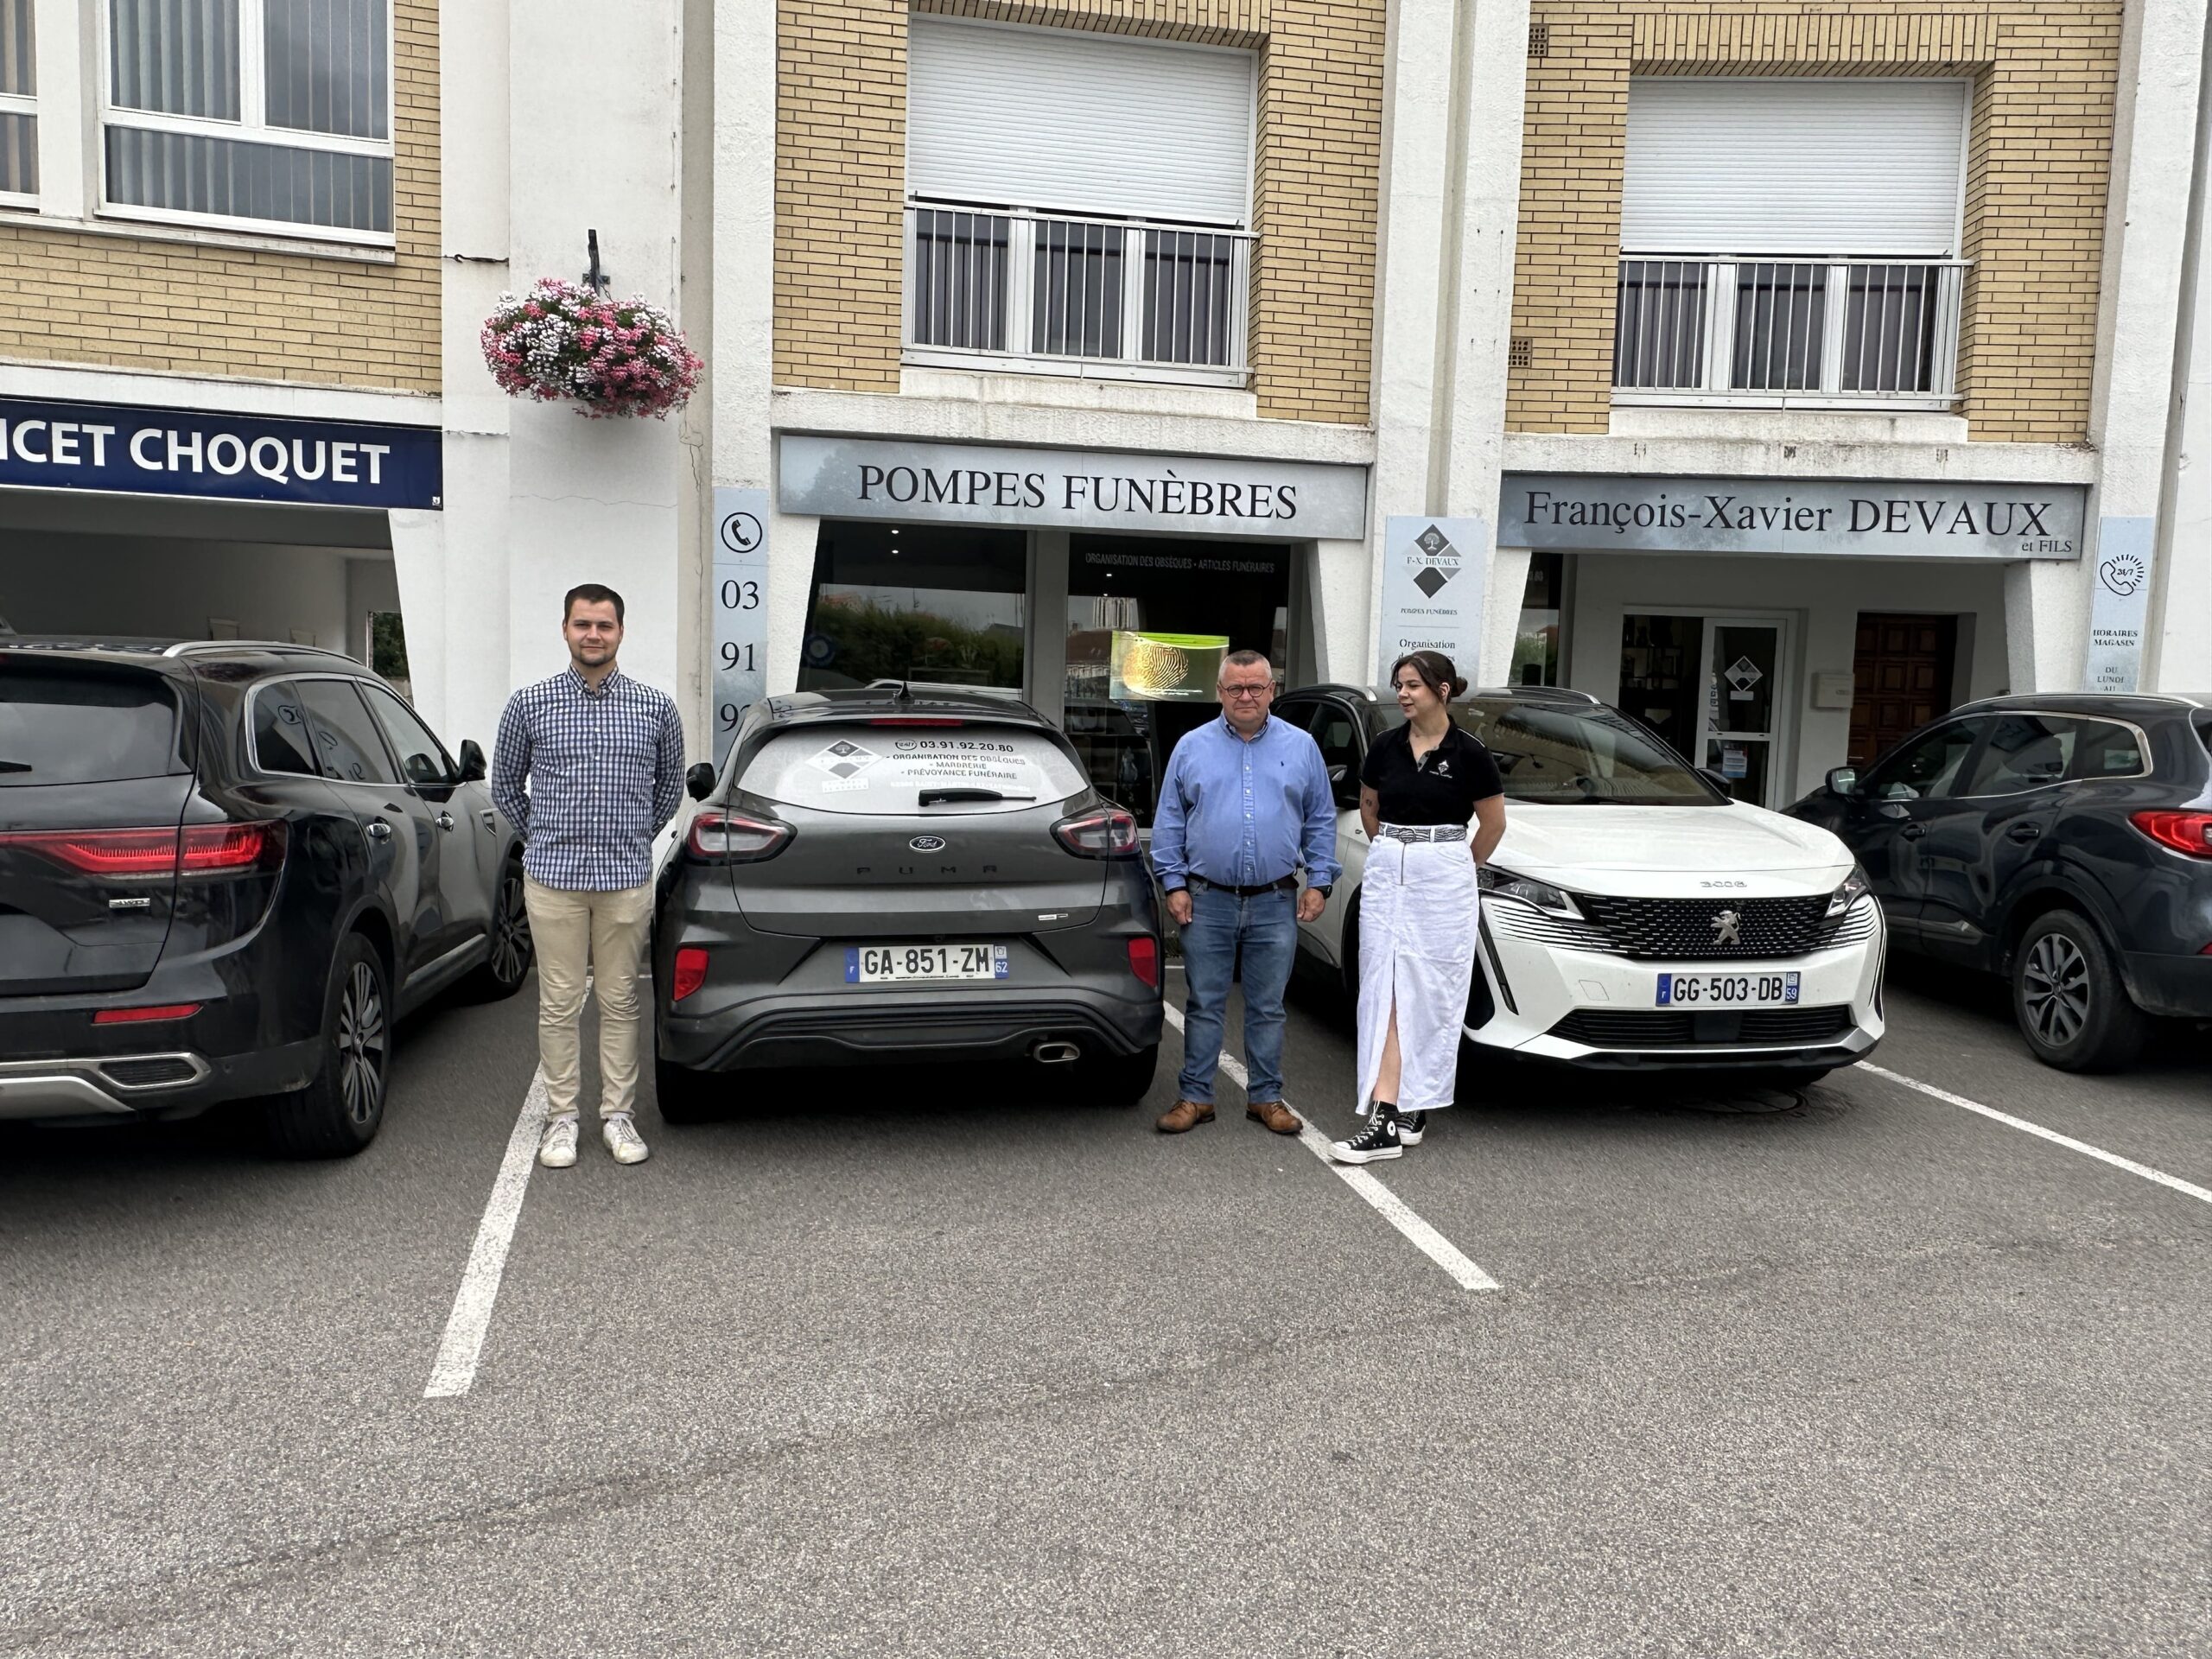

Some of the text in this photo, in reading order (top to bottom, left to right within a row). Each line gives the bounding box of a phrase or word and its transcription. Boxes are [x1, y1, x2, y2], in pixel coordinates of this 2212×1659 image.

[130, 428, 391, 485] CHOQUET
[857, 464, 1298, 519] POMPES FUNÈBRES
[1525, 491, 2053, 537] François-Xavier DEVAUX
[2022, 540, 2073, 553] et FILS
[1085, 553, 1139, 567] ORGANISATION
[1140, 556, 1154, 567] DES
[1198, 559, 1231, 571] ARTICLES
[1426, 557, 1459, 566] DEVAUX
[721, 580, 760, 610] 03
[2093, 629, 2139, 638] HORAIRES
[1399, 639, 1456, 651] Organisation
[721, 642, 757, 671] 91
[920, 741, 1014, 753] 03.91.92.20.80
[907, 767, 967, 777] PRÉVOYANCE
[917, 838, 938, 849] Ford
[864, 947, 989, 975] GA-851-ZM
[995, 961, 1008, 973] 62
[1674, 977, 1783, 1001] GG-503-DB
[1786, 988, 1797, 1001] 59
